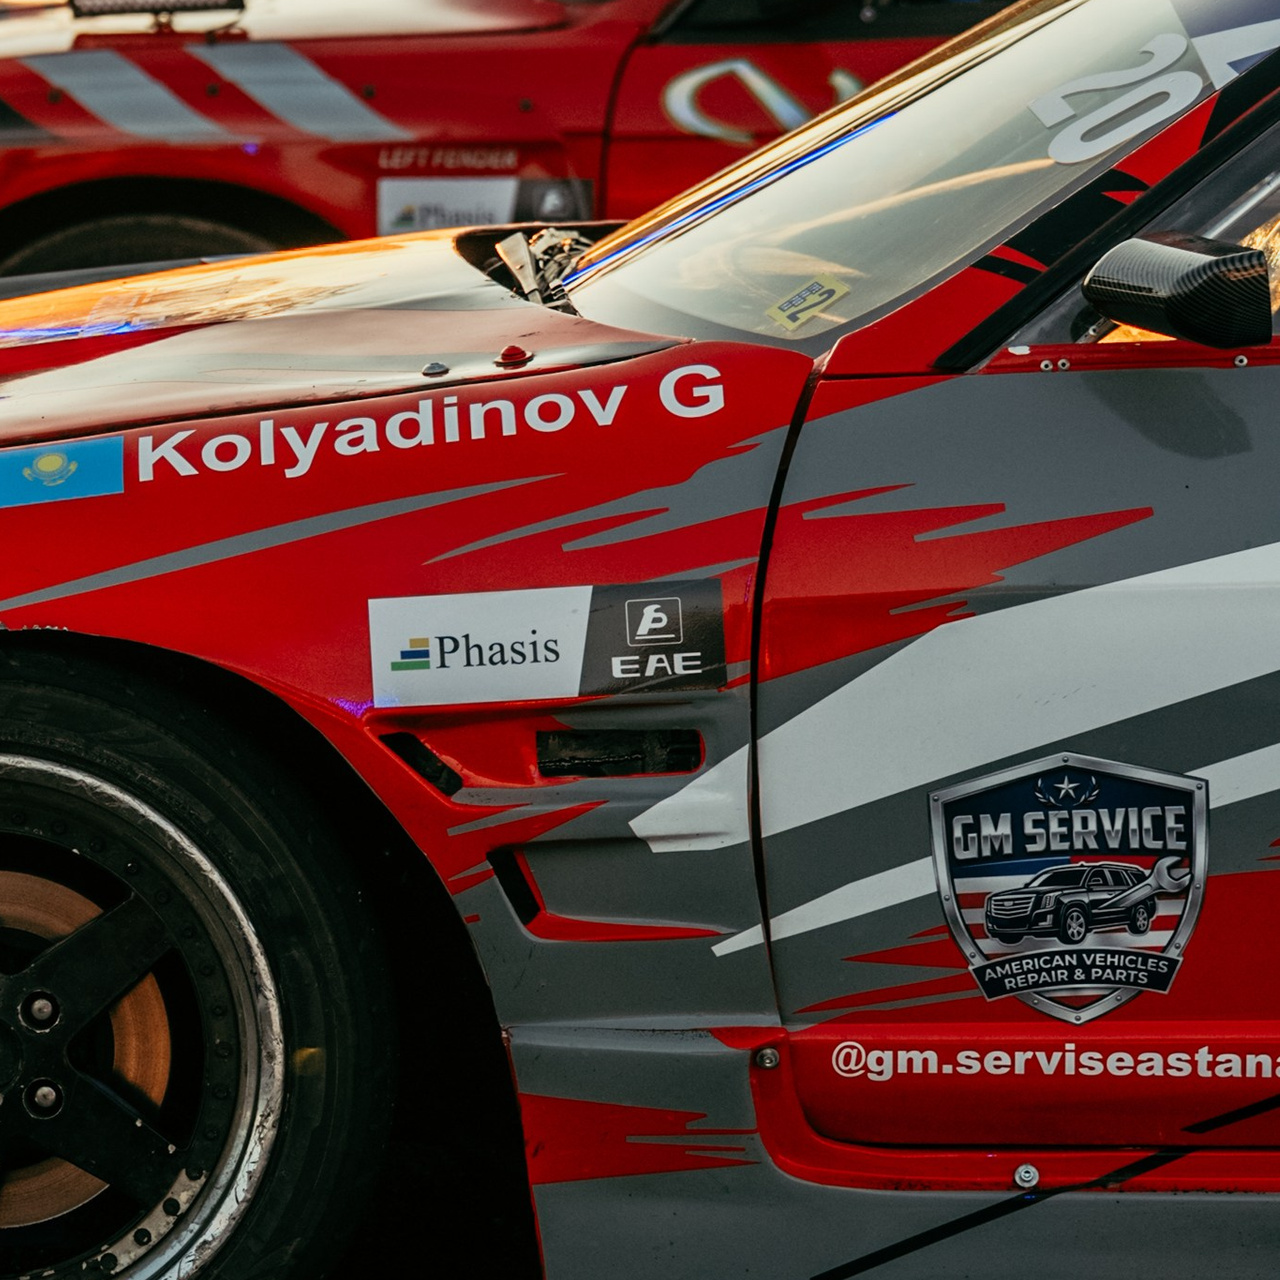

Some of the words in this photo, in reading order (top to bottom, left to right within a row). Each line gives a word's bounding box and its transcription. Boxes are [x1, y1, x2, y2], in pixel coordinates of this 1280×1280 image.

[1027, 33, 1203, 164] 20
[138, 384, 628, 482] Kolyadinov
[659, 364, 726, 418] G
[434, 628, 560, 669] Phasis
[611, 652, 703, 678] EAE
[952, 813, 1014, 860] GM
[1023, 806, 1188, 852] SERVICE
[984, 953, 1077, 982] AMERICAN
[1082, 953, 1170, 974] VEHICLES
[1004, 970, 1068, 991] REPAIR
[1073, 968, 1086, 981] &
[1091, 968, 1149, 984] PARTS
